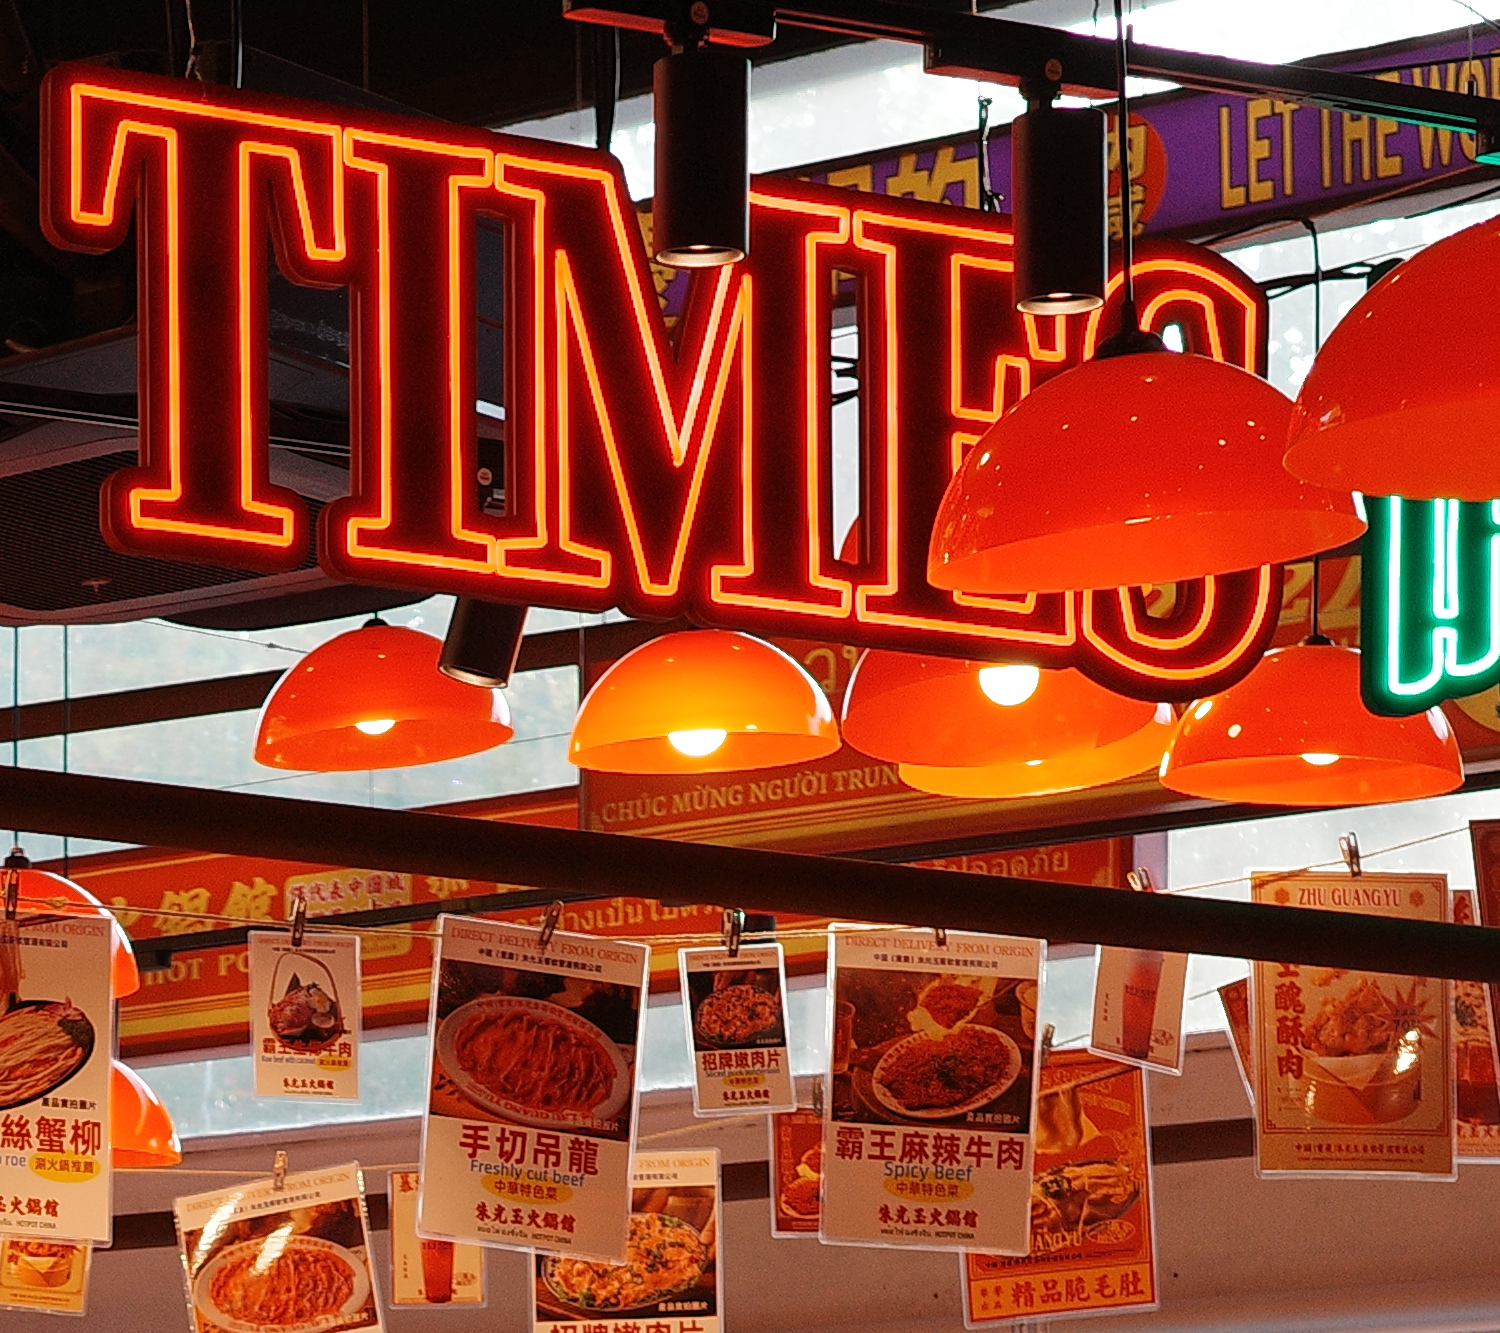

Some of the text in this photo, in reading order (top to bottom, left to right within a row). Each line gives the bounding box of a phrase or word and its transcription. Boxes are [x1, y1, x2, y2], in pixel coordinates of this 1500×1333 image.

[1219, 100, 1300, 210] LET
[40, 62, 1278, 704] TIMES
[831, 764, 899, 793] TRUN
[1298, 886, 1402, 908] ZHU GUANGYU
[451, 926, 639, 965] DIRECT DELIVY FROM ORIGIN
[844, 934, 890, 948] DIRECT
[955, 941, 991, 955] FROM
[992, 944, 1035, 958] ORIGIN
[4, 1155, 27, 1168] roe
[458, 1124, 600, 1177] 手切吊龍
[834, 1126, 1025, 1171] 霸王麻辣牛肉
[470, 1159, 587, 1188] Freshly cut beef
[884, 1161, 973, 1182] Spicy Beef
[1010, 1270, 1146, 1309] 精品脆毛肚
